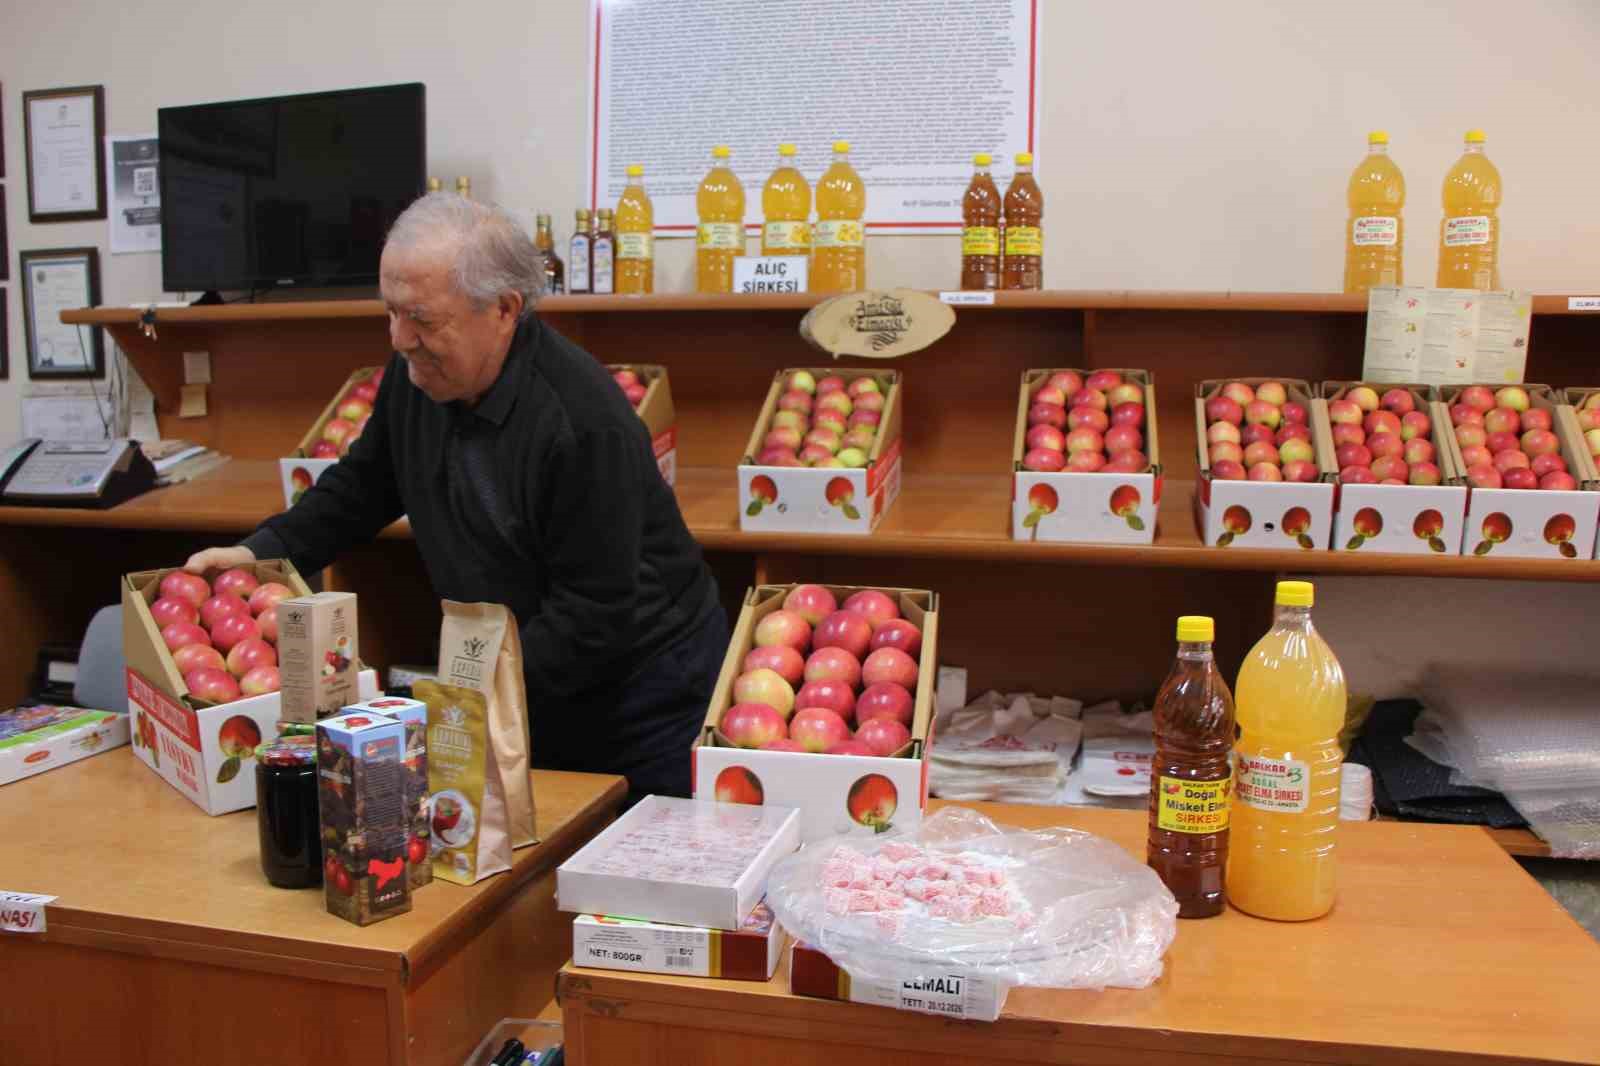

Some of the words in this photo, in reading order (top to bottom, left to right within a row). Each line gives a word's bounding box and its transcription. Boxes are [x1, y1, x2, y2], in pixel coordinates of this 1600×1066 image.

[754, 262, 787, 278] ALIÇ
[742, 280, 799, 293] SİRKESİ
[1185, 789, 1217, 801] Doğal
[1167, 799, 1204, 812] Misket
[590, 948, 611, 958] NET:
[612, 952, 642, 962] 800GR
[902, 997, 925, 1009] TETT:
